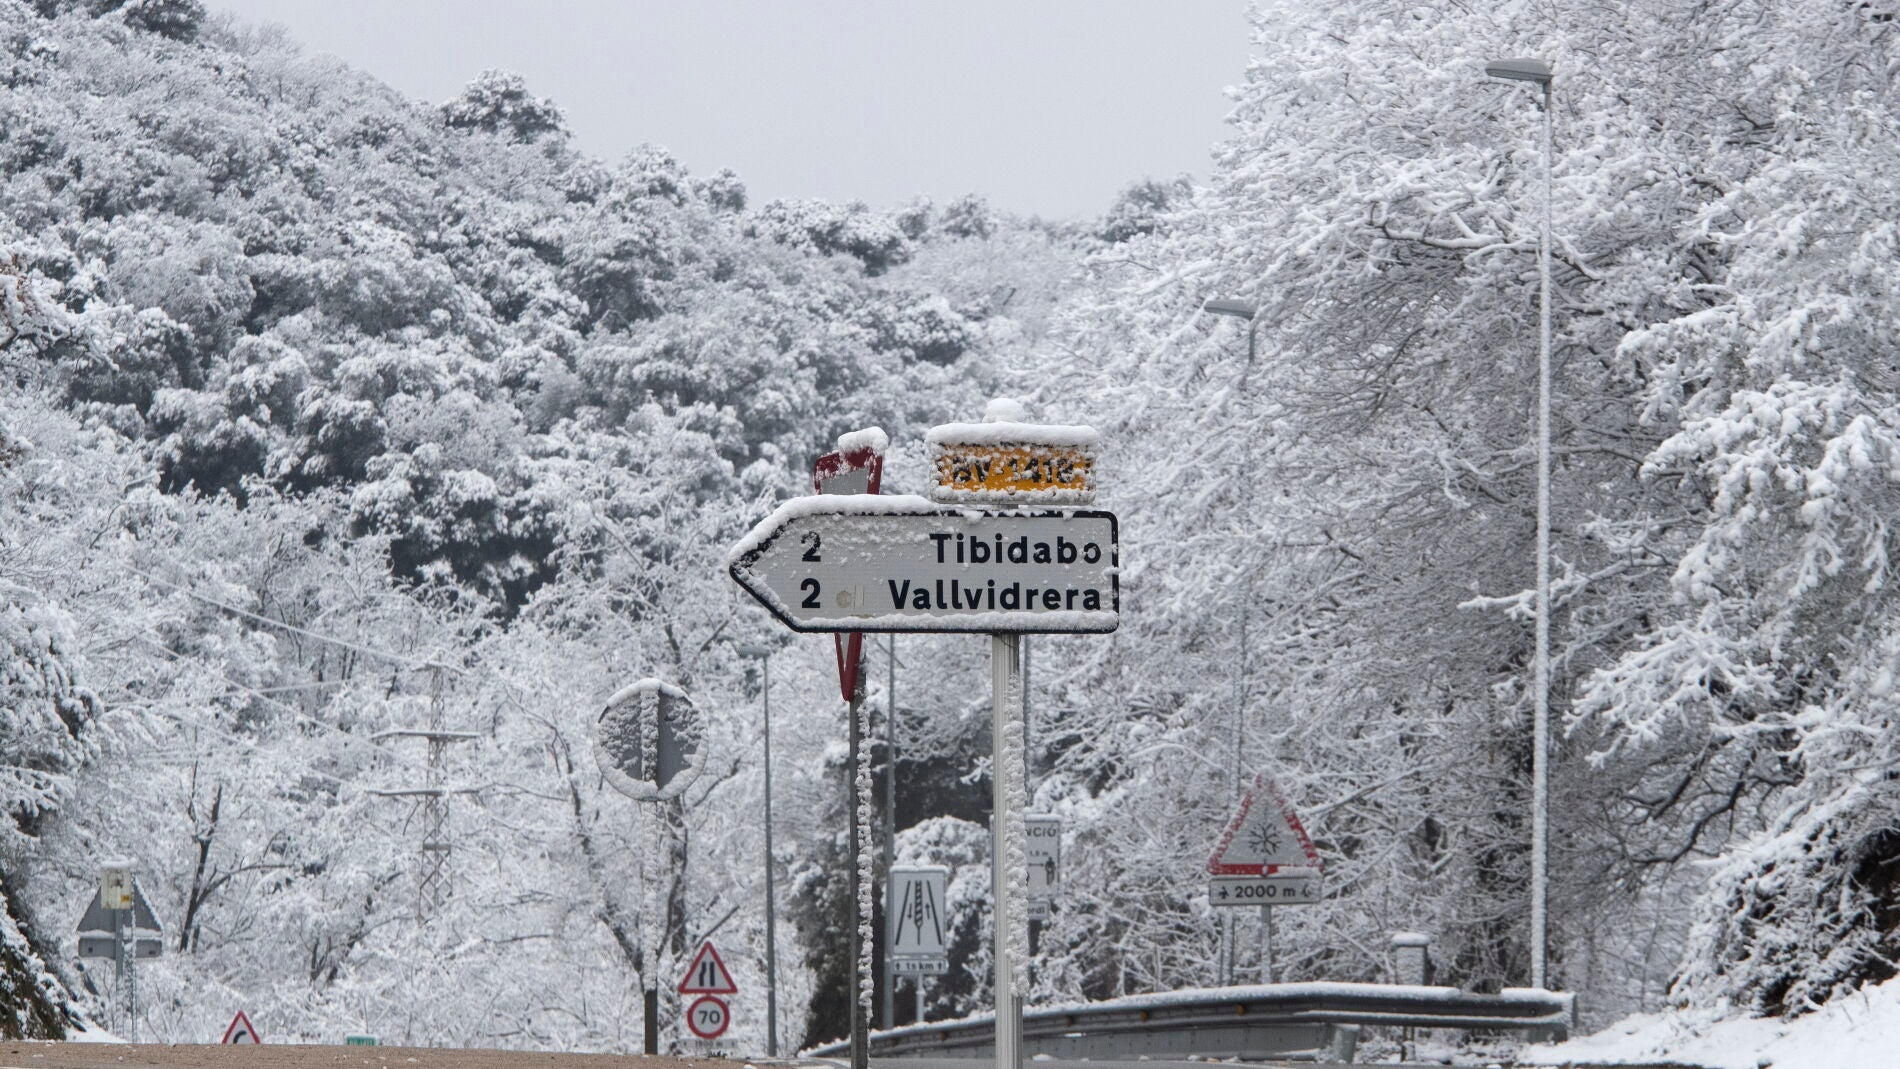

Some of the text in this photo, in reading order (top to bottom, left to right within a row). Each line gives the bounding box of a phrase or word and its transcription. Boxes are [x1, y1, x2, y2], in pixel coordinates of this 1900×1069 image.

[801, 531, 1102, 564] 2 Tibidabo
[800, 578, 1101, 611] 2 Vallvidrera
[1235, 885, 1296, 898] 2000 m
[698, 1010, 721, 1025] 70
